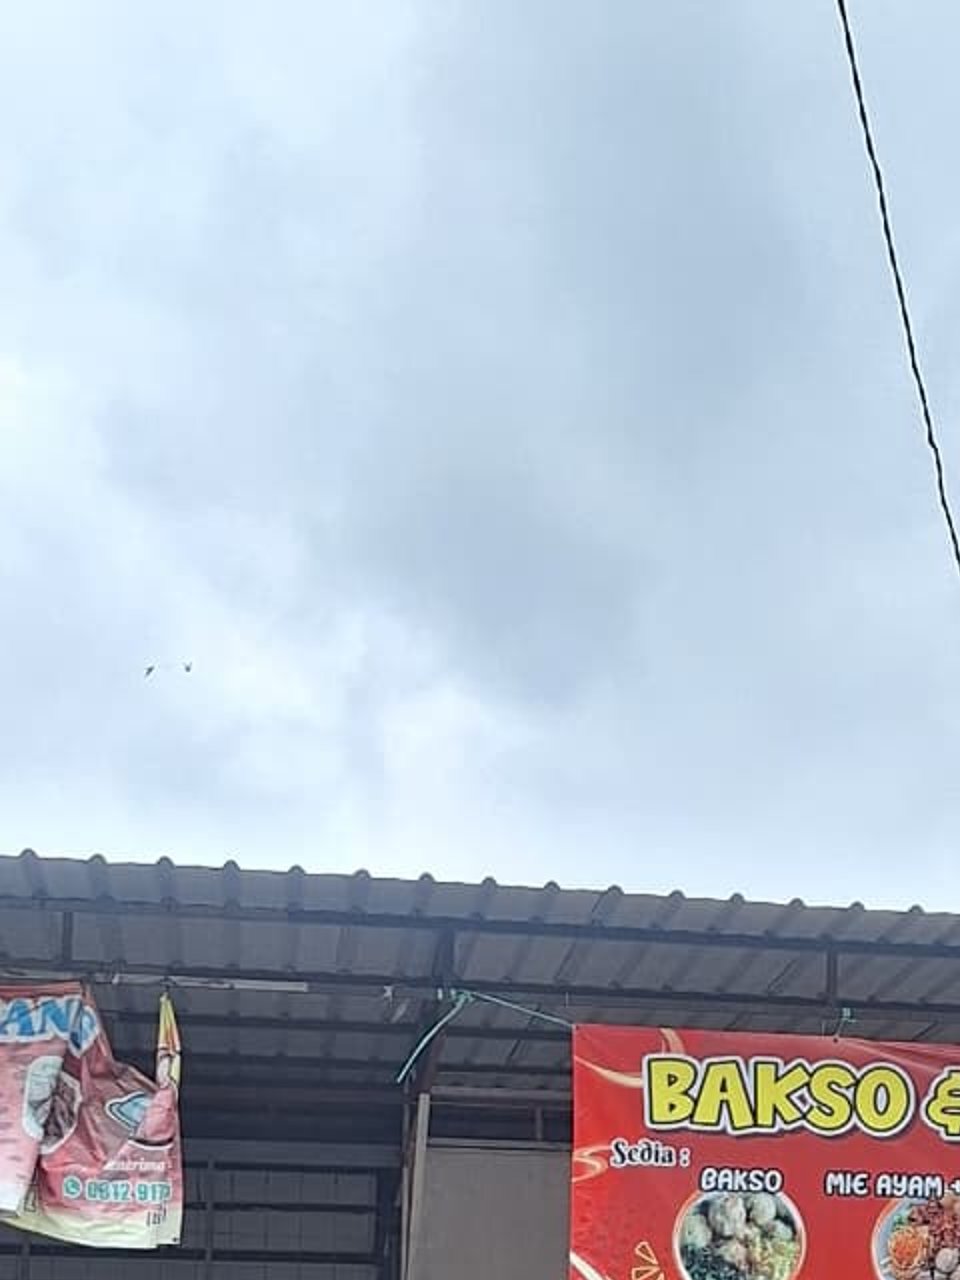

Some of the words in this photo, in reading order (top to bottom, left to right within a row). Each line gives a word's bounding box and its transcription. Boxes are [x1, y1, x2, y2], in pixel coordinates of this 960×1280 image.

[644, 1054, 914, 1135] BAKSO
[700, 1168, 783, 1192] BAKSO
[825, 1173, 868, 1196] MIE
[876, 1175, 943, 1198] AYAM
